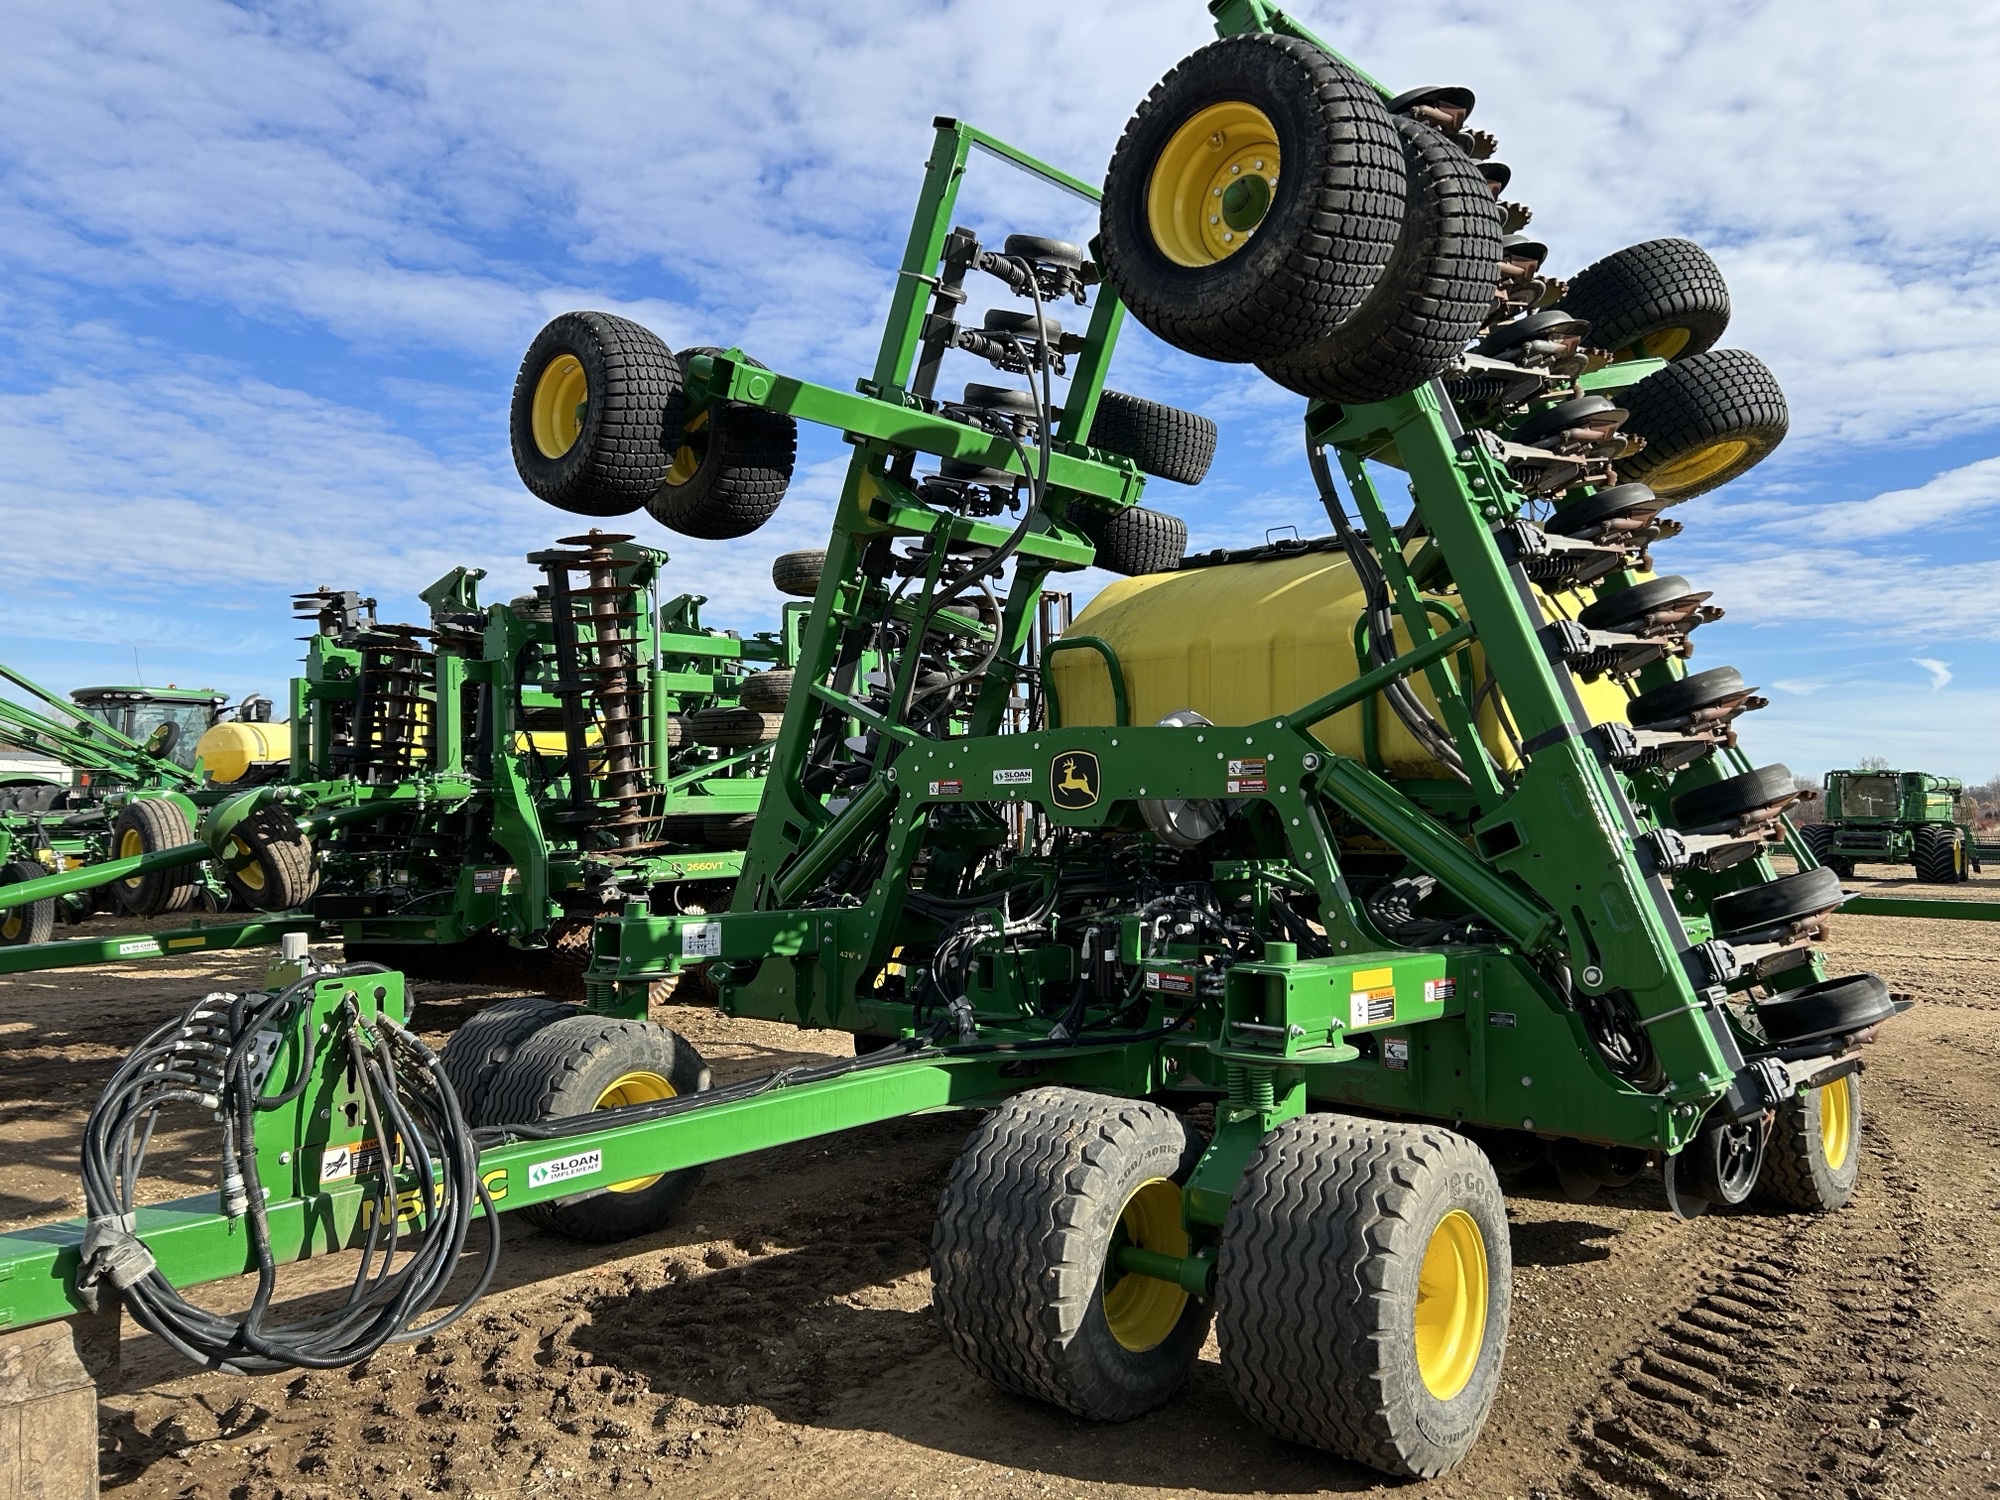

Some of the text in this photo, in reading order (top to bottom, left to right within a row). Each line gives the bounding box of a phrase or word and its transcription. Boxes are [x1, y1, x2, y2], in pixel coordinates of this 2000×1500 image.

[1004, 771, 1031, 779] SLOAN
[687, 861, 724, 871] 2660VT
[551, 1153, 599, 1172] SLOAN
[551, 1163, 599, 1180] IMPLEMENT
